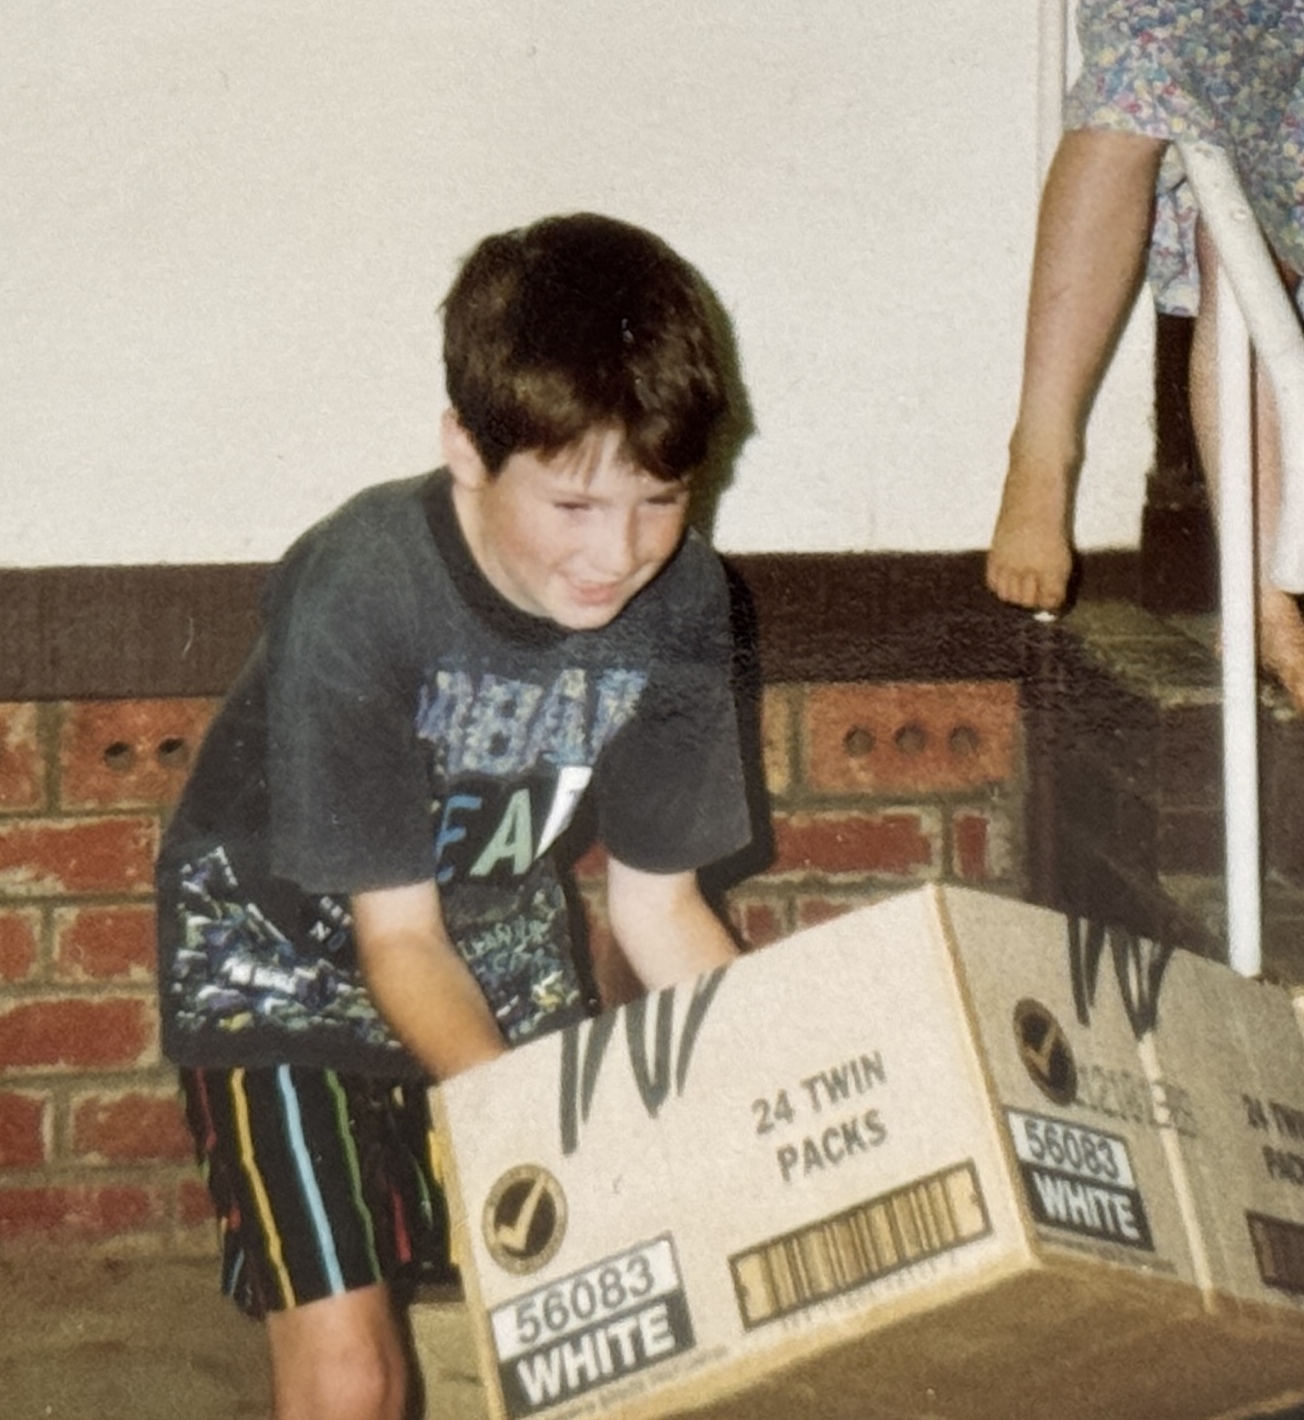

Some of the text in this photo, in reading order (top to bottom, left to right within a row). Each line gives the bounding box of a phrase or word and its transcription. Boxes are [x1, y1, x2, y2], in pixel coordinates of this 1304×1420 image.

[751, 1049, 887, 1135] 24 TWIN
[776, 1108, 888, 1183] PACKS
[1024, 1119, 1120, 1180] 56083
[1031, 1171, 1141, 1240] WHITE
[515, 1254, 655, 1344] 56083
[516, 1300, 676, 1406] WHITE
